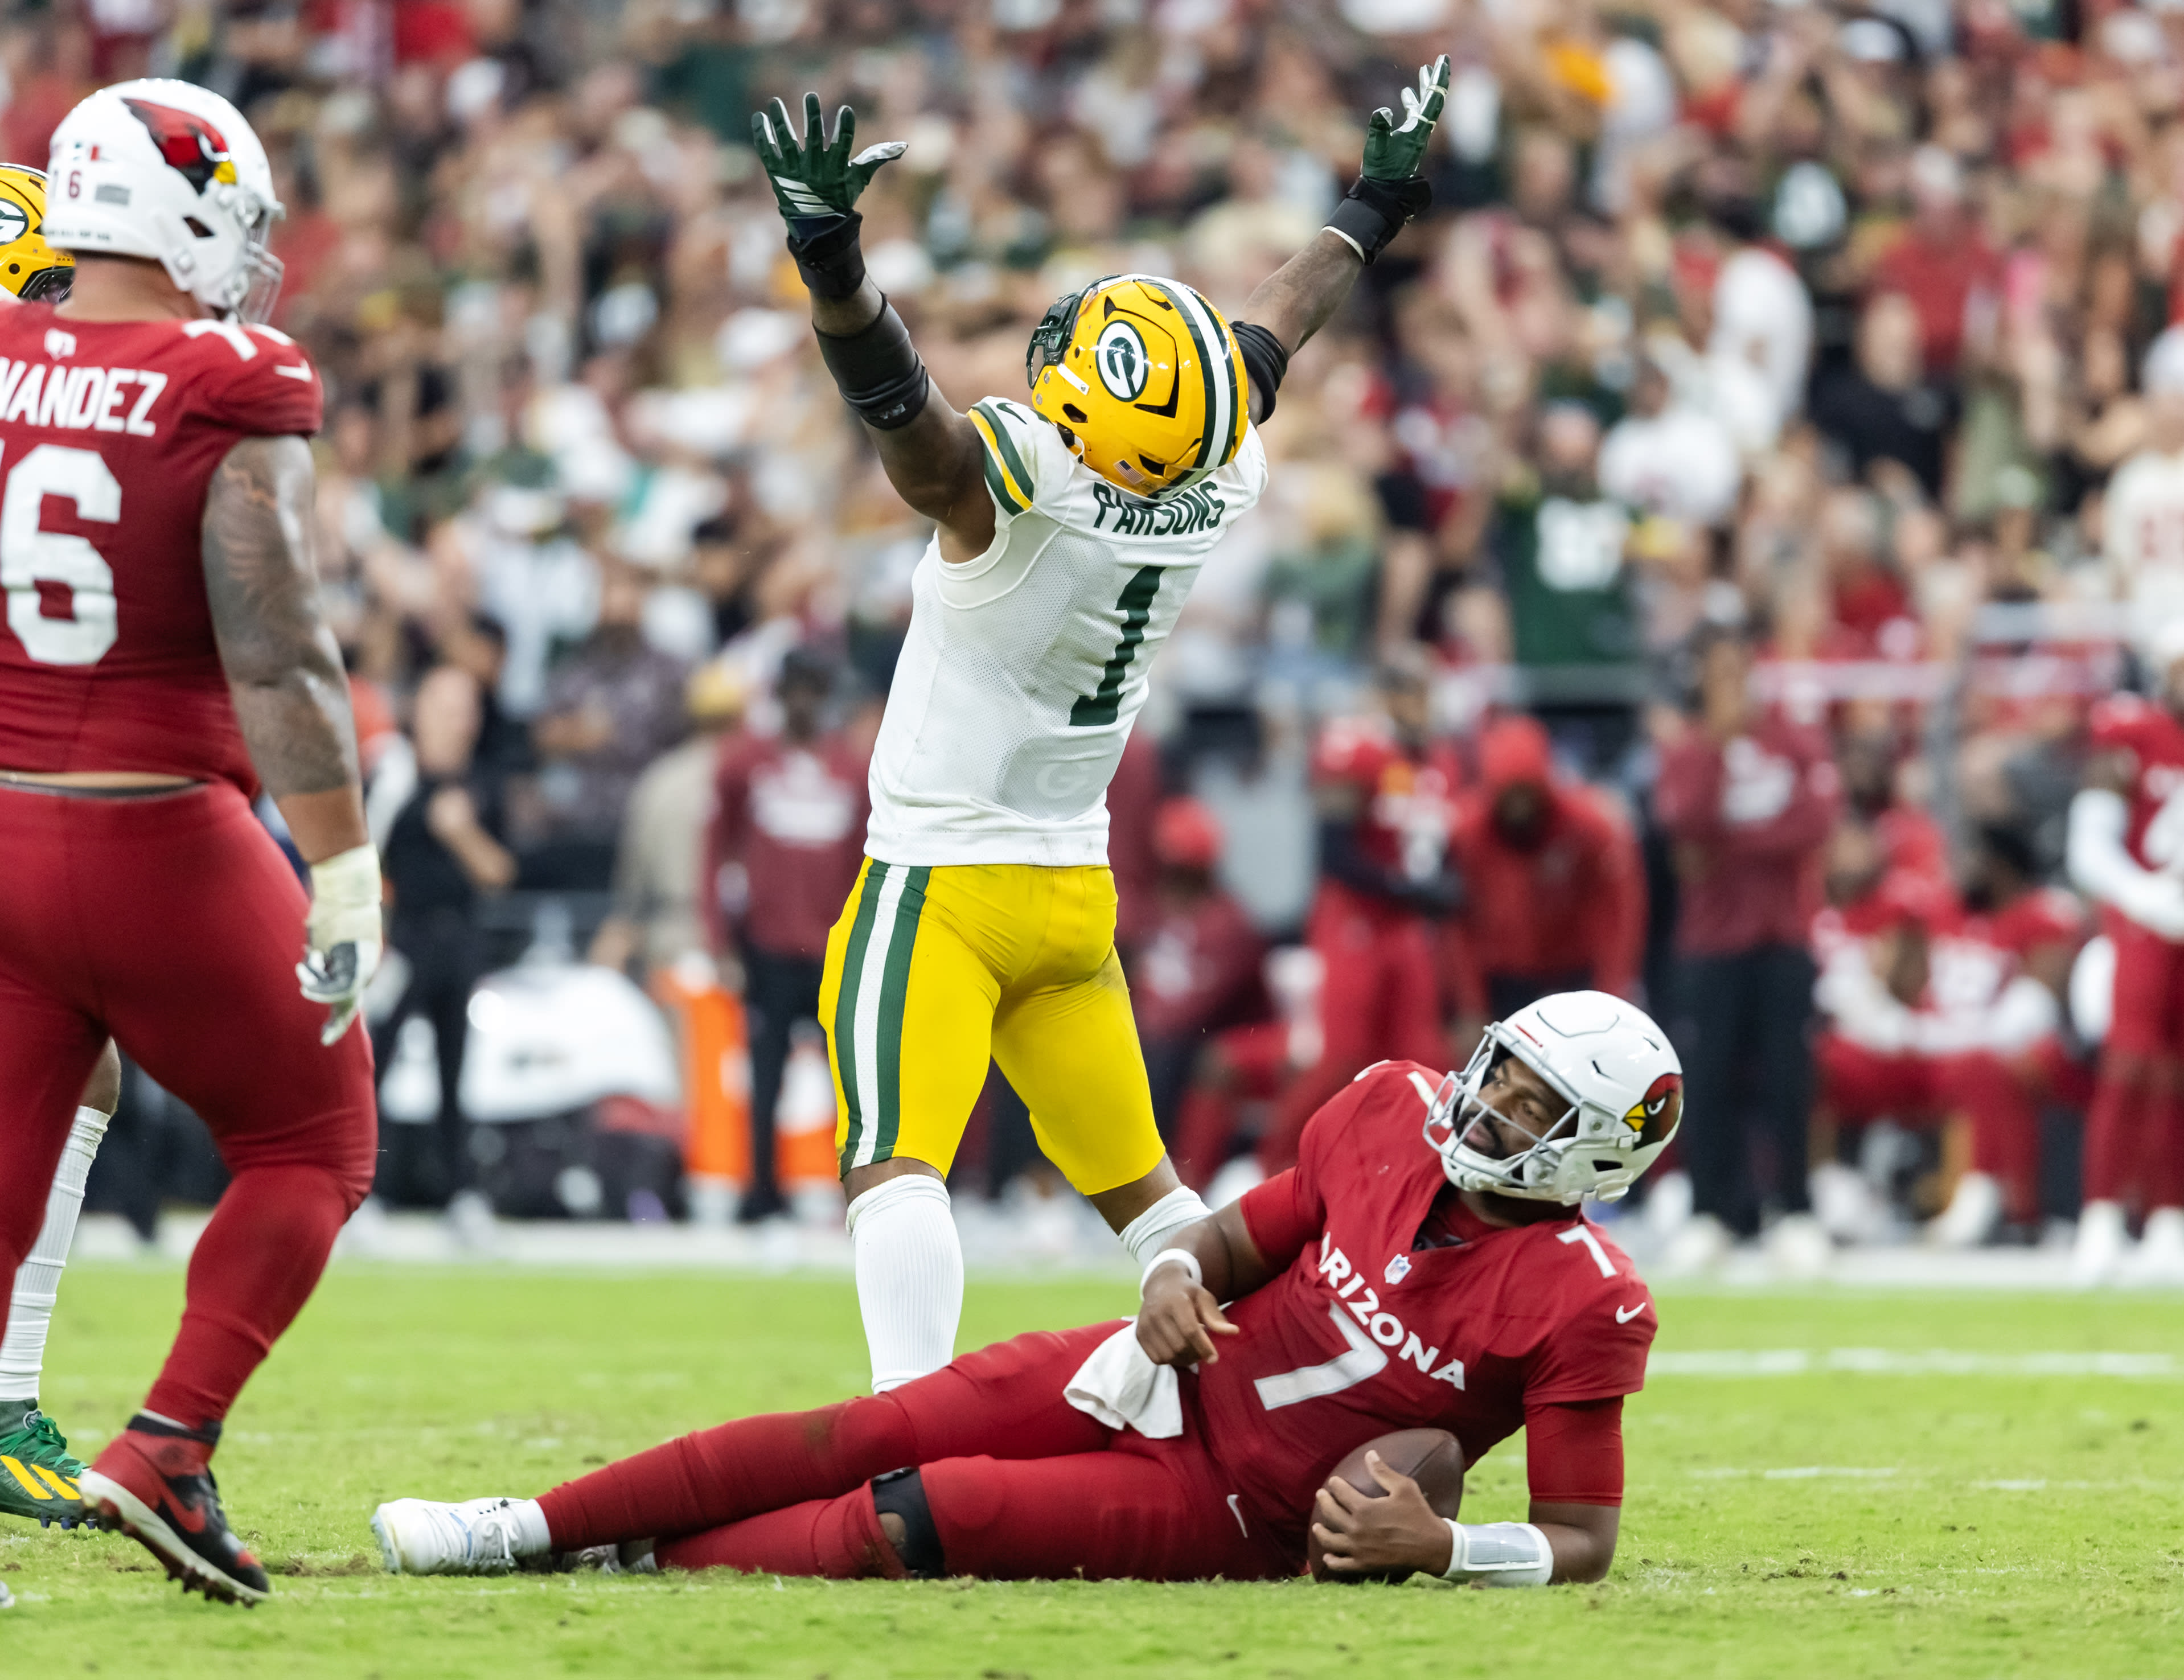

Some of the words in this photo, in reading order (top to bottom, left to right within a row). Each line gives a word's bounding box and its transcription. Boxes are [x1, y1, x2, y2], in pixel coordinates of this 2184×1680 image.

[1069, 565, 1167, 726] 1
[1557, 1224, 1616, 1278] 7
[1254, 1299, 1389, 1410] 7
